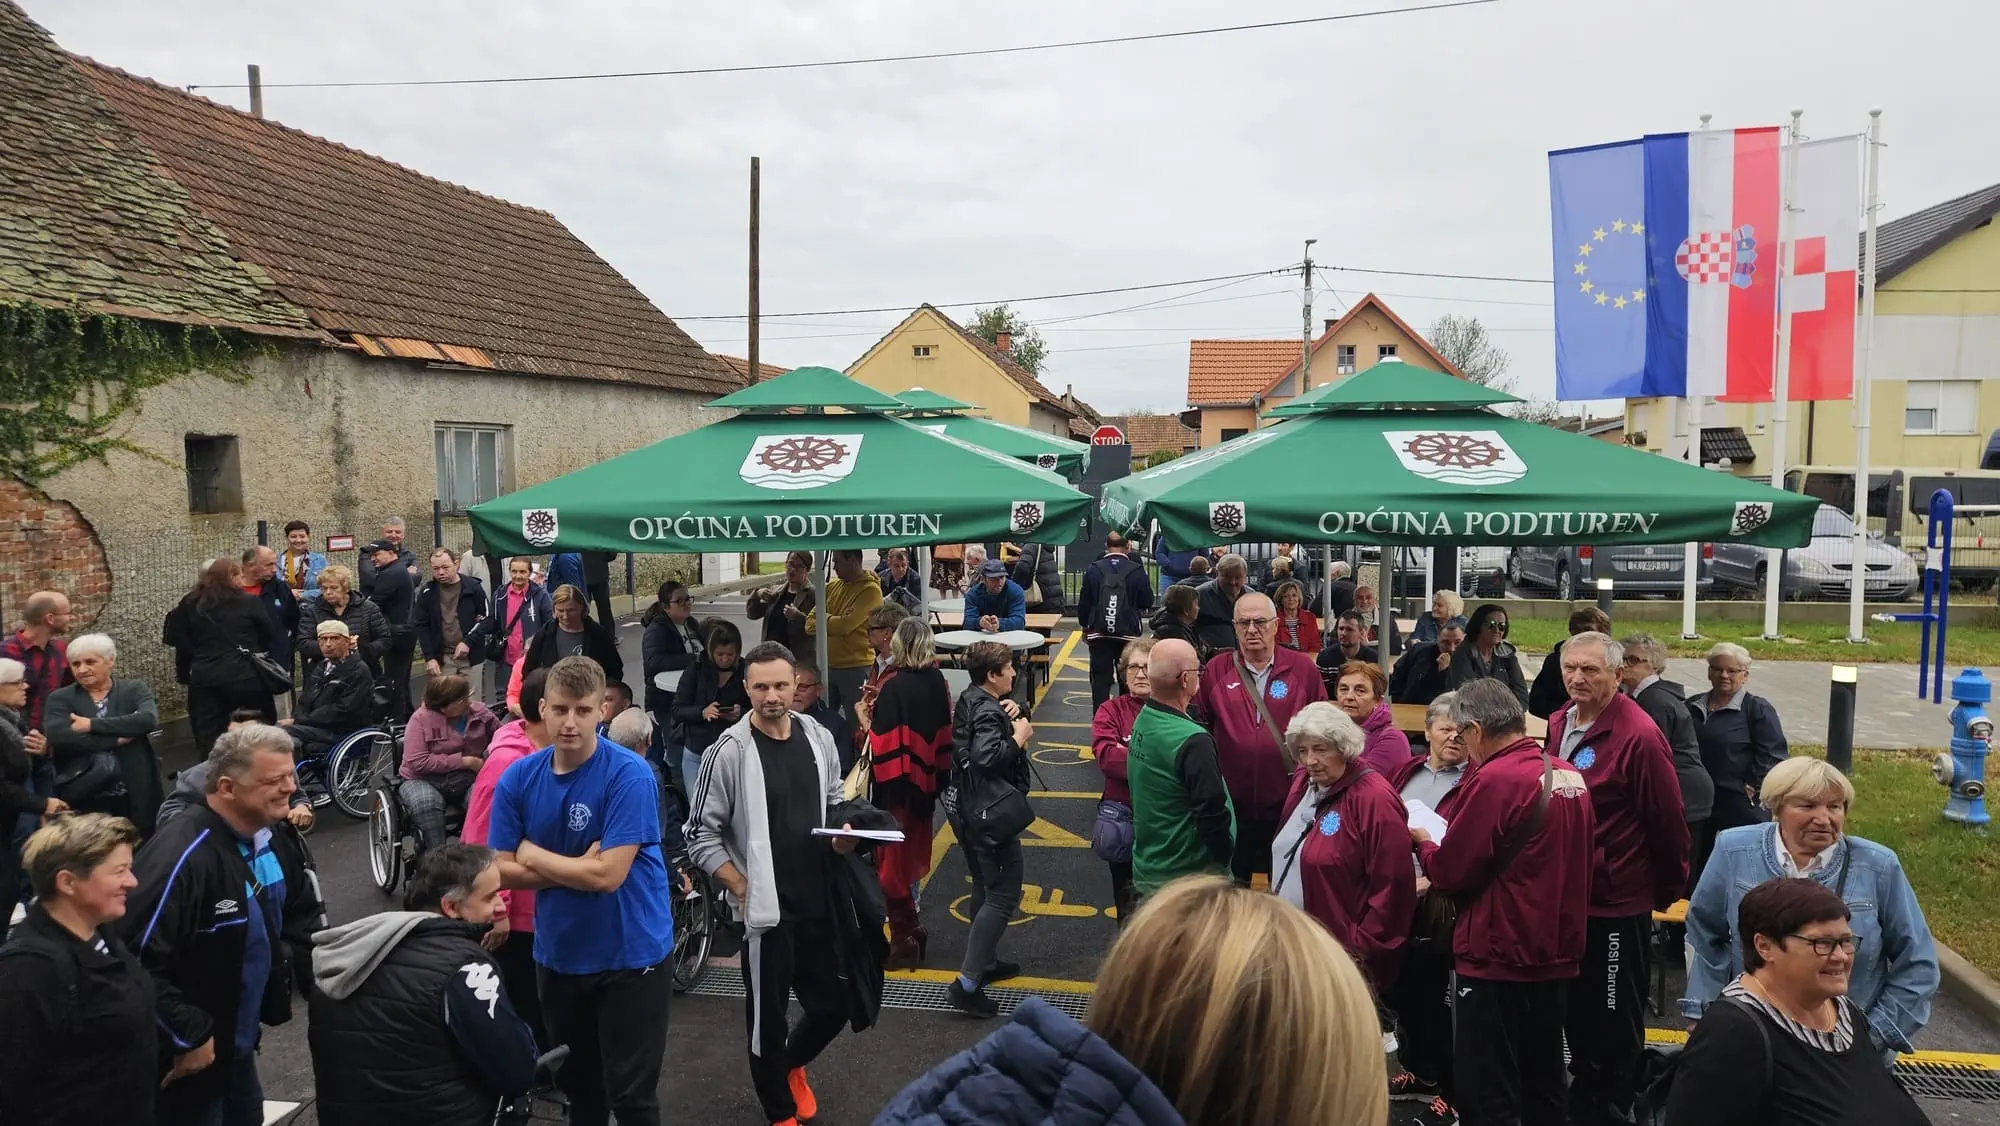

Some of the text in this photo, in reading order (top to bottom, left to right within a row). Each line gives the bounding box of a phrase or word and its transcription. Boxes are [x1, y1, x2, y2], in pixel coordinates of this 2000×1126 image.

[1093, 436, 1122, 446] STOP
[629, 511, 942, 540] OPĆINA PODTUREN
[1318, 506, 1659, 536] OPĆINA PODTUREN
[1105, 595, 1117, 633] adidas
[1607, 932, 1620, 1011] UOSI Daruvar
